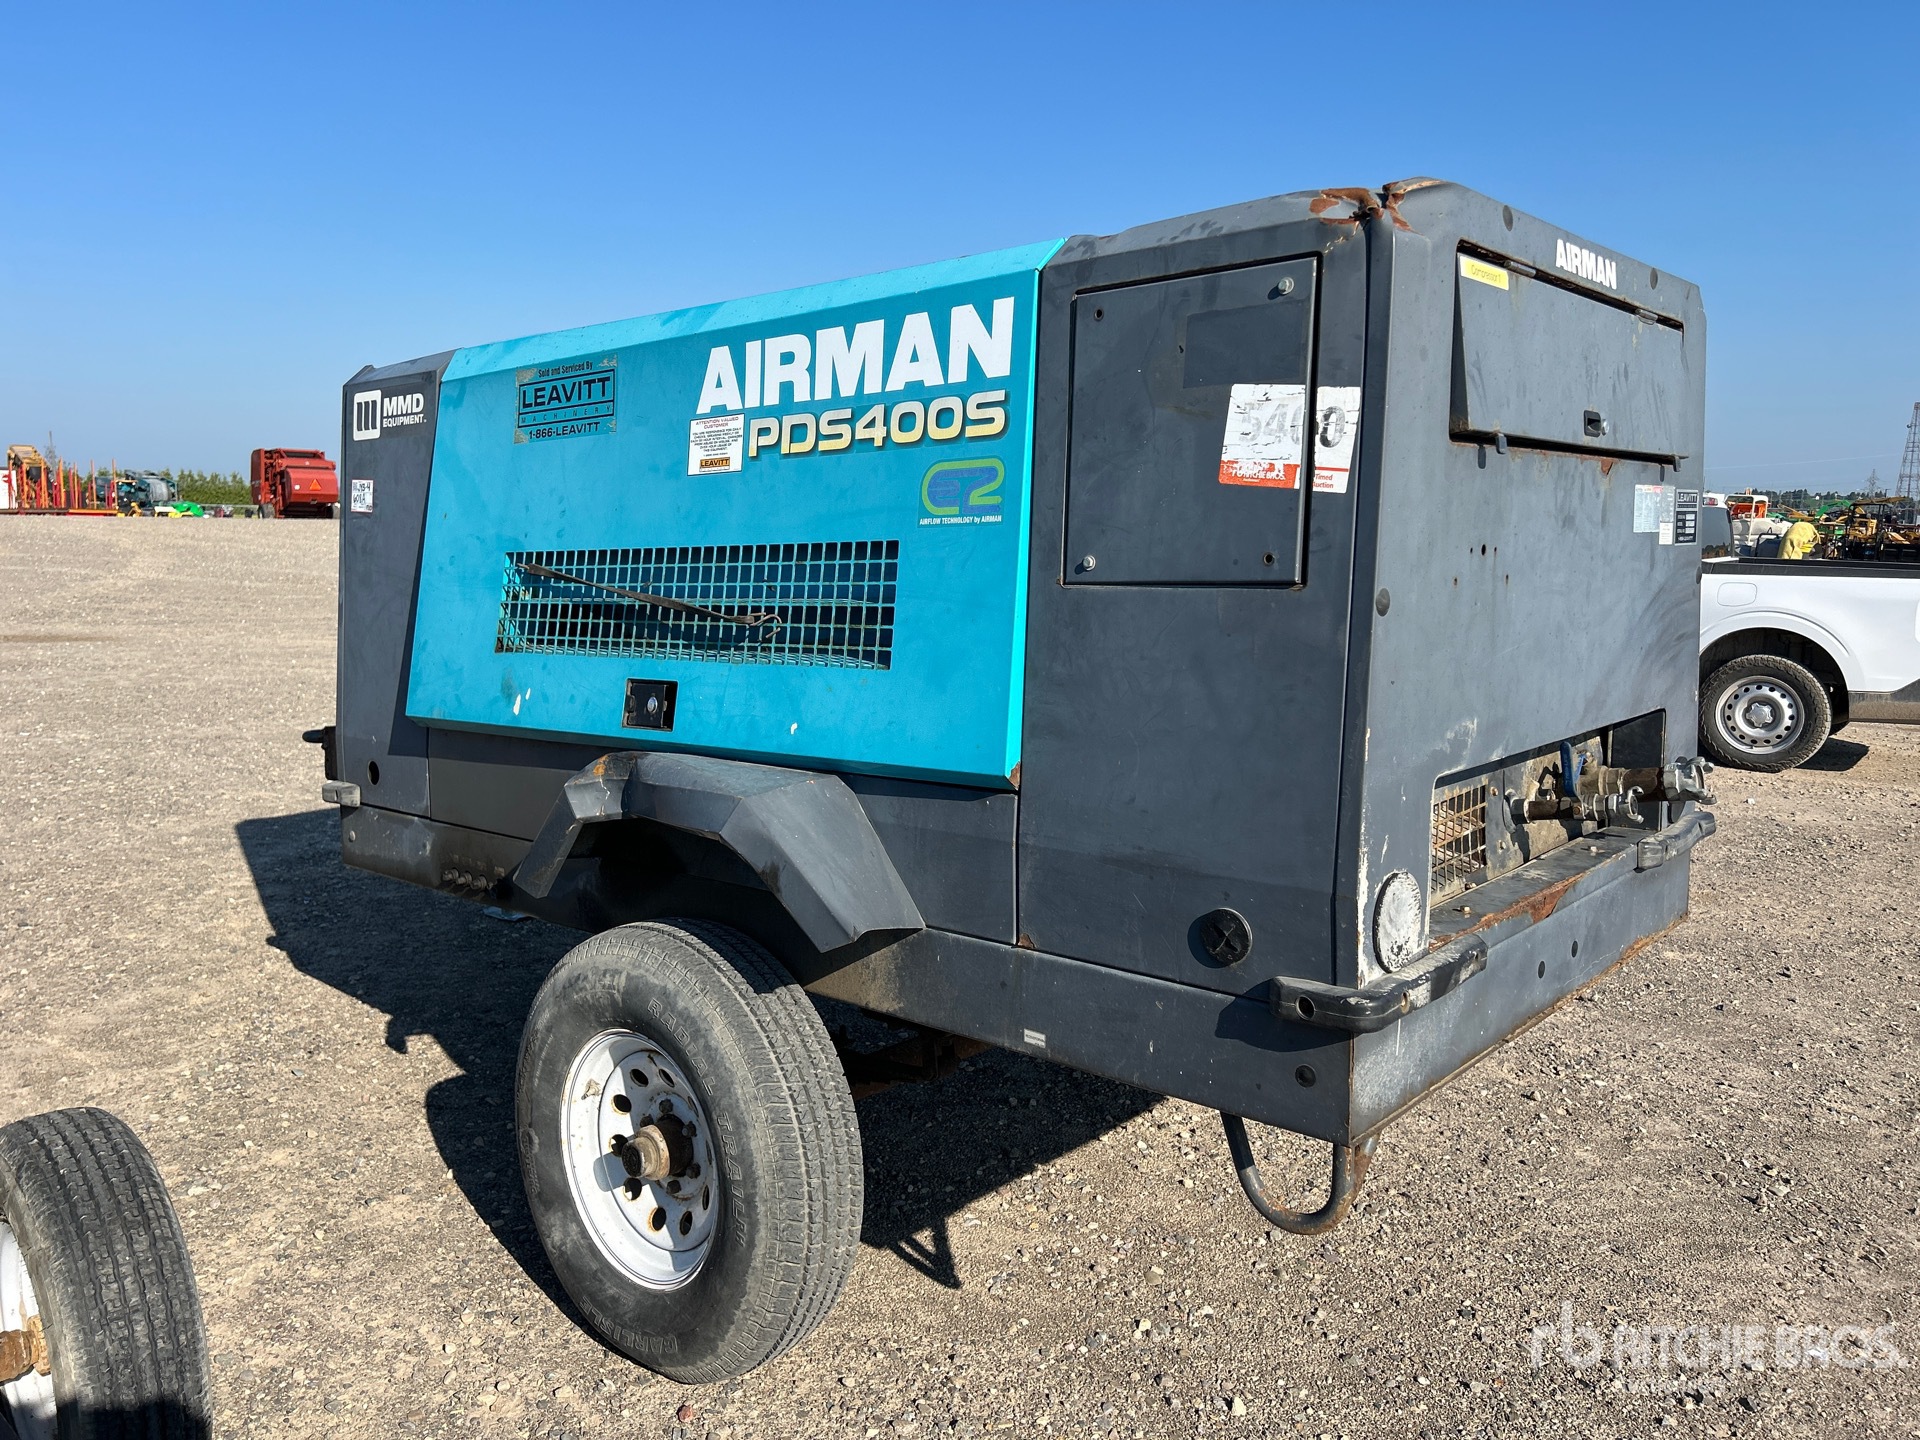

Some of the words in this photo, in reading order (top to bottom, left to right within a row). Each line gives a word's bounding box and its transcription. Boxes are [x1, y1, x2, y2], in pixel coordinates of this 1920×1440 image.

[1555, 239, 1617, 290] AIRMAN
[696, 296, 1014, 414] AIRMAN
[538, 367, 550, 378] Sold
[551, 366, 560, 376] and
[561, 361, 585, 374] Serviced
[586, 360, 593, 370] By
[522, 376, 611, 409] LEAVITT
[383, 393, 425, 417] MMD
[521, 405, 612, 423] MACHINERY
[529, 421, 600, 439] 1-866-LEAVITT
[703, 422, 729, 430] CUSTOMER
[748, 389, 1007, 457] PDS400S
[701, 459, 729, 467] LEAVITT
[1315, 473, 1333, 481] Timed
[919, 517, 941, 526] AIRFLOW
[941, 516, 974, 525] TECHNOLOGY
[974, 516, 981, 524] by
[647, 997, 716, 1096] RADIAL
[580, 1296, 679, 1354] CARLISLE
